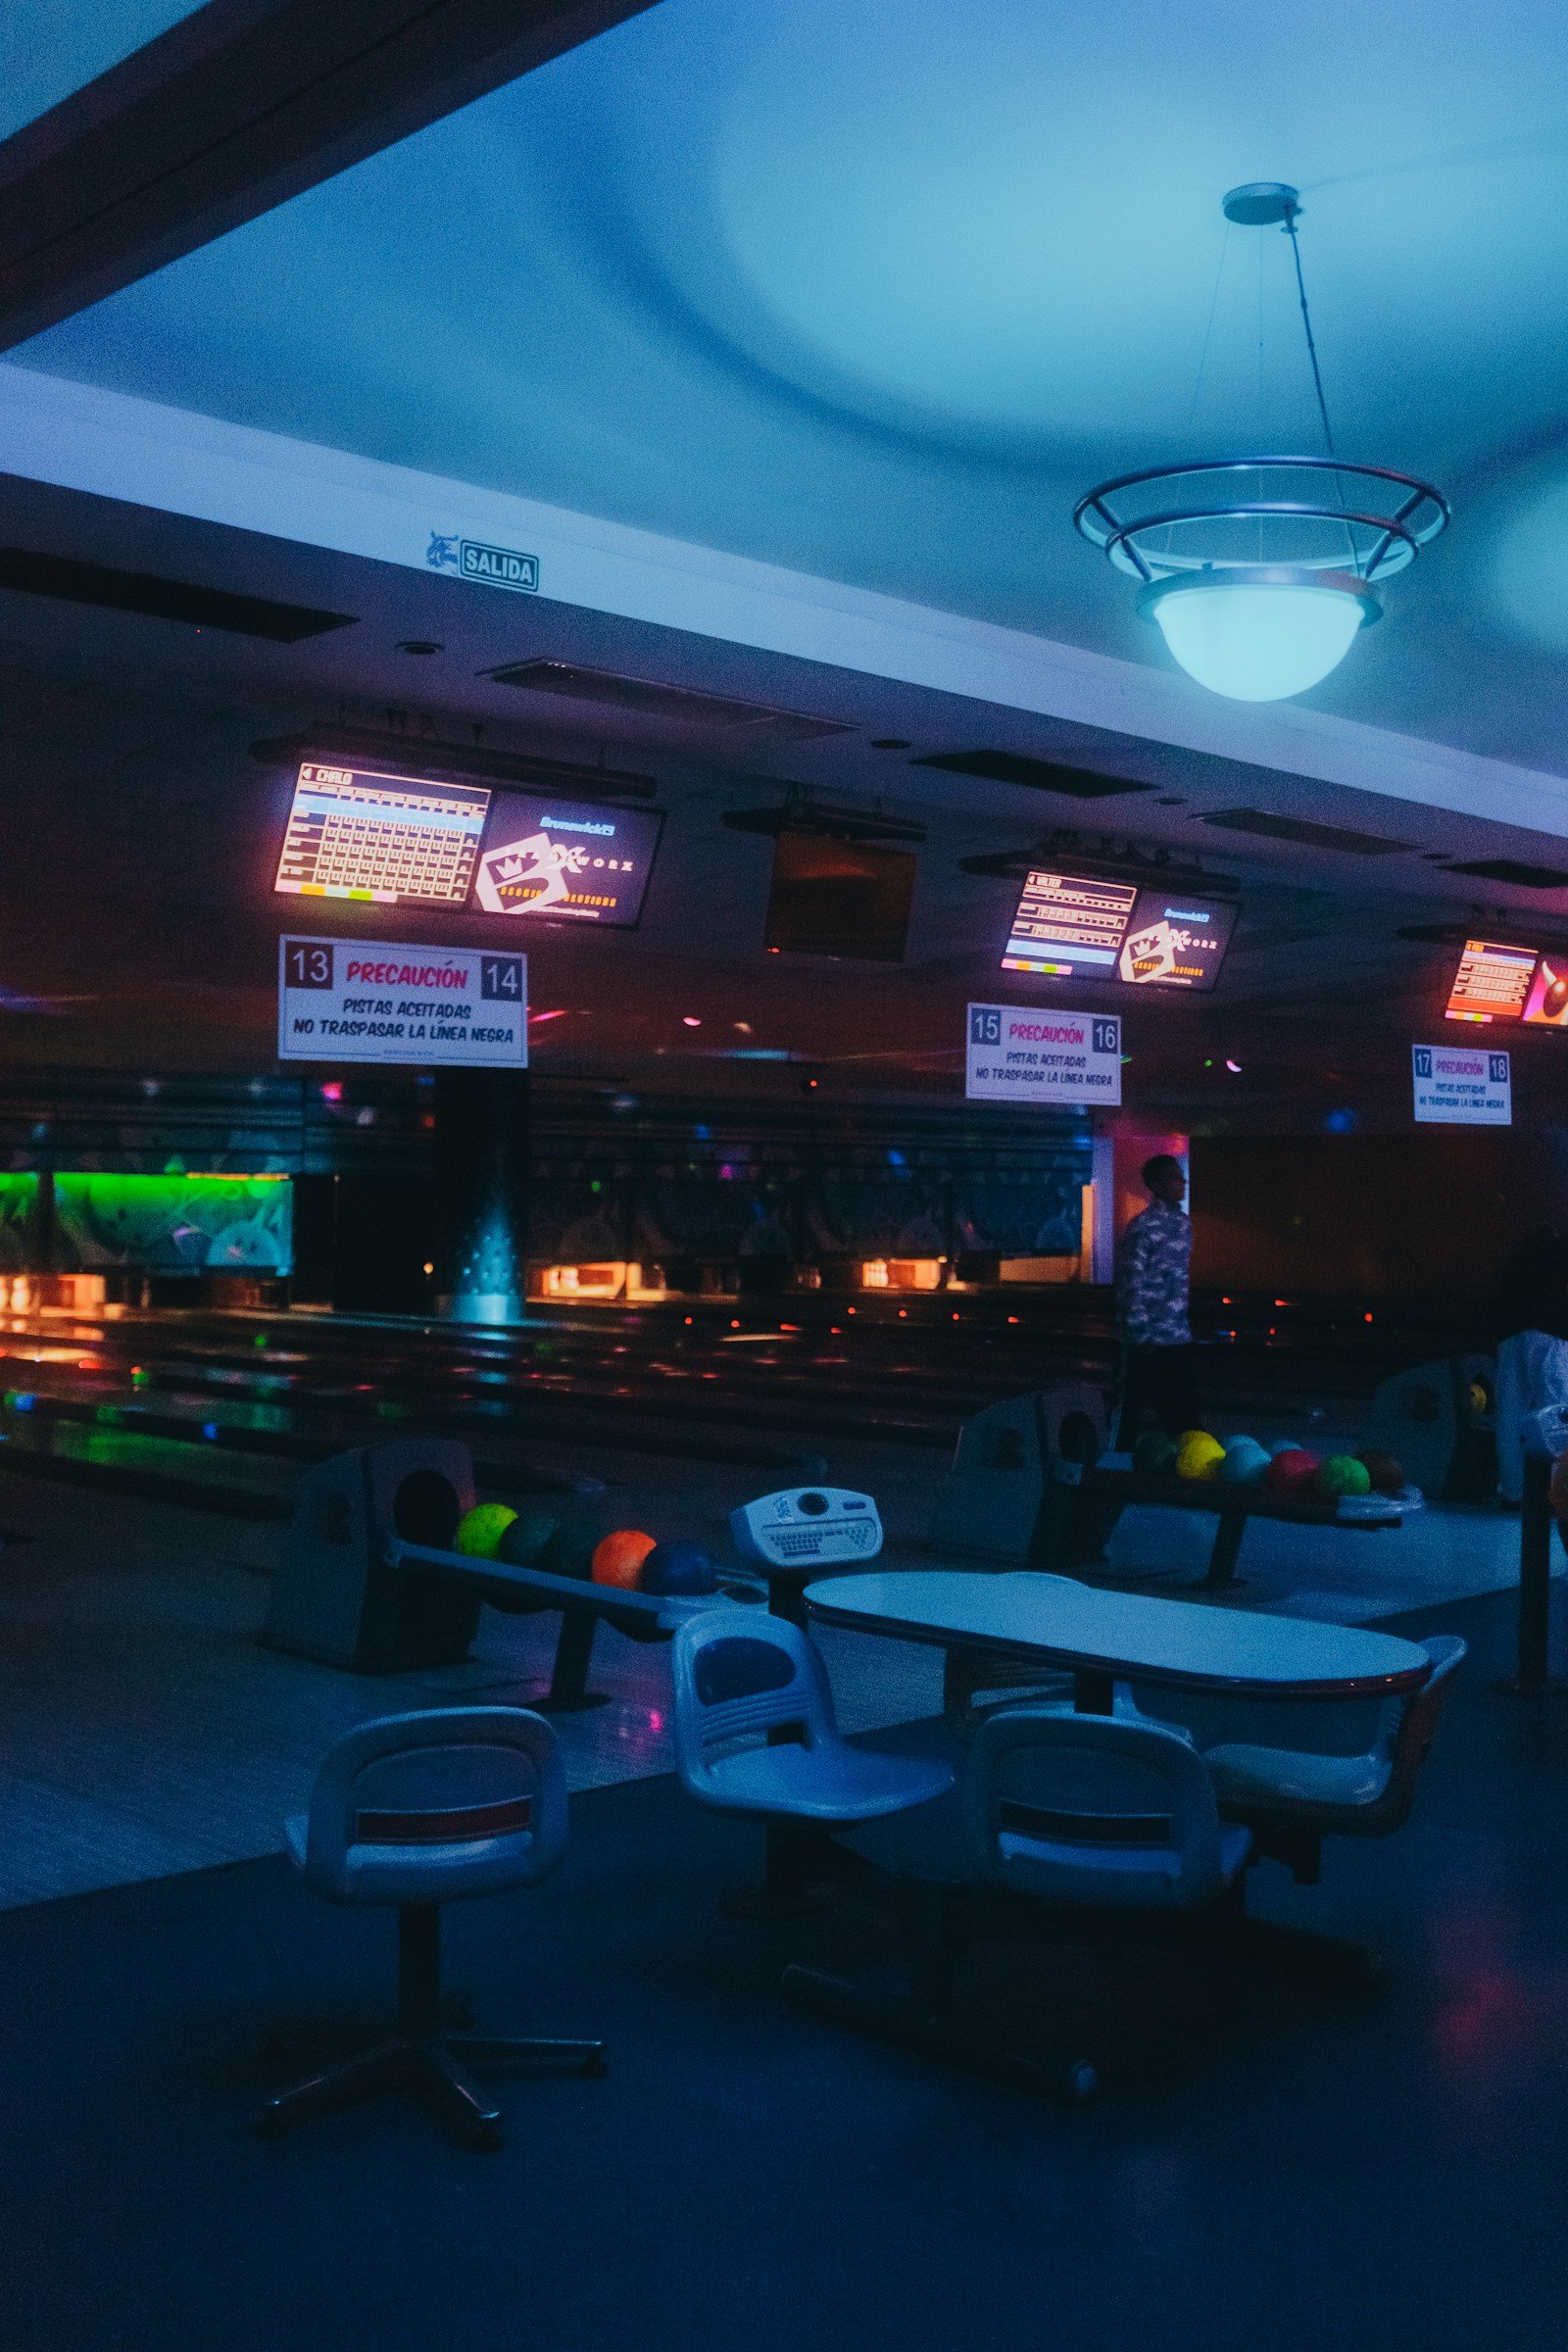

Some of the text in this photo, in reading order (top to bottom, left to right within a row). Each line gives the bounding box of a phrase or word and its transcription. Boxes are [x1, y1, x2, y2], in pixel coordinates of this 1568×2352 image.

[466, 549, 533, 584] SALIDA
[294, 950, 328, 982] 13
[346, 960, 467, 989] PRECAUCIÓN
[486, 964, 517, 995] 14
[344, 999, 471, 1019] PISTAS ACEITADAS
[293, 1019, 514, 1044] NO TRASPASAR LA LÍNEA NEGRA
[975, 1015, 999, 1040] 15
[1009, 1021, 1084, 1044] PRECAUCIÓN
[1096, 1024, 1116, 1049] 16
[1006, 1052, 1038, 1065] PISTAS
[1417, 1053, 1431, 1074] 17
[1492, 1058, 1507, 1078] 18
[975, 1067, 989, 1080] NO
[992, 1068, 1045, 1082] TRASPASAR
[1048, 1071, 1057, 1083] LA
[1086, 1074, 1112, 1086] NEGRA
